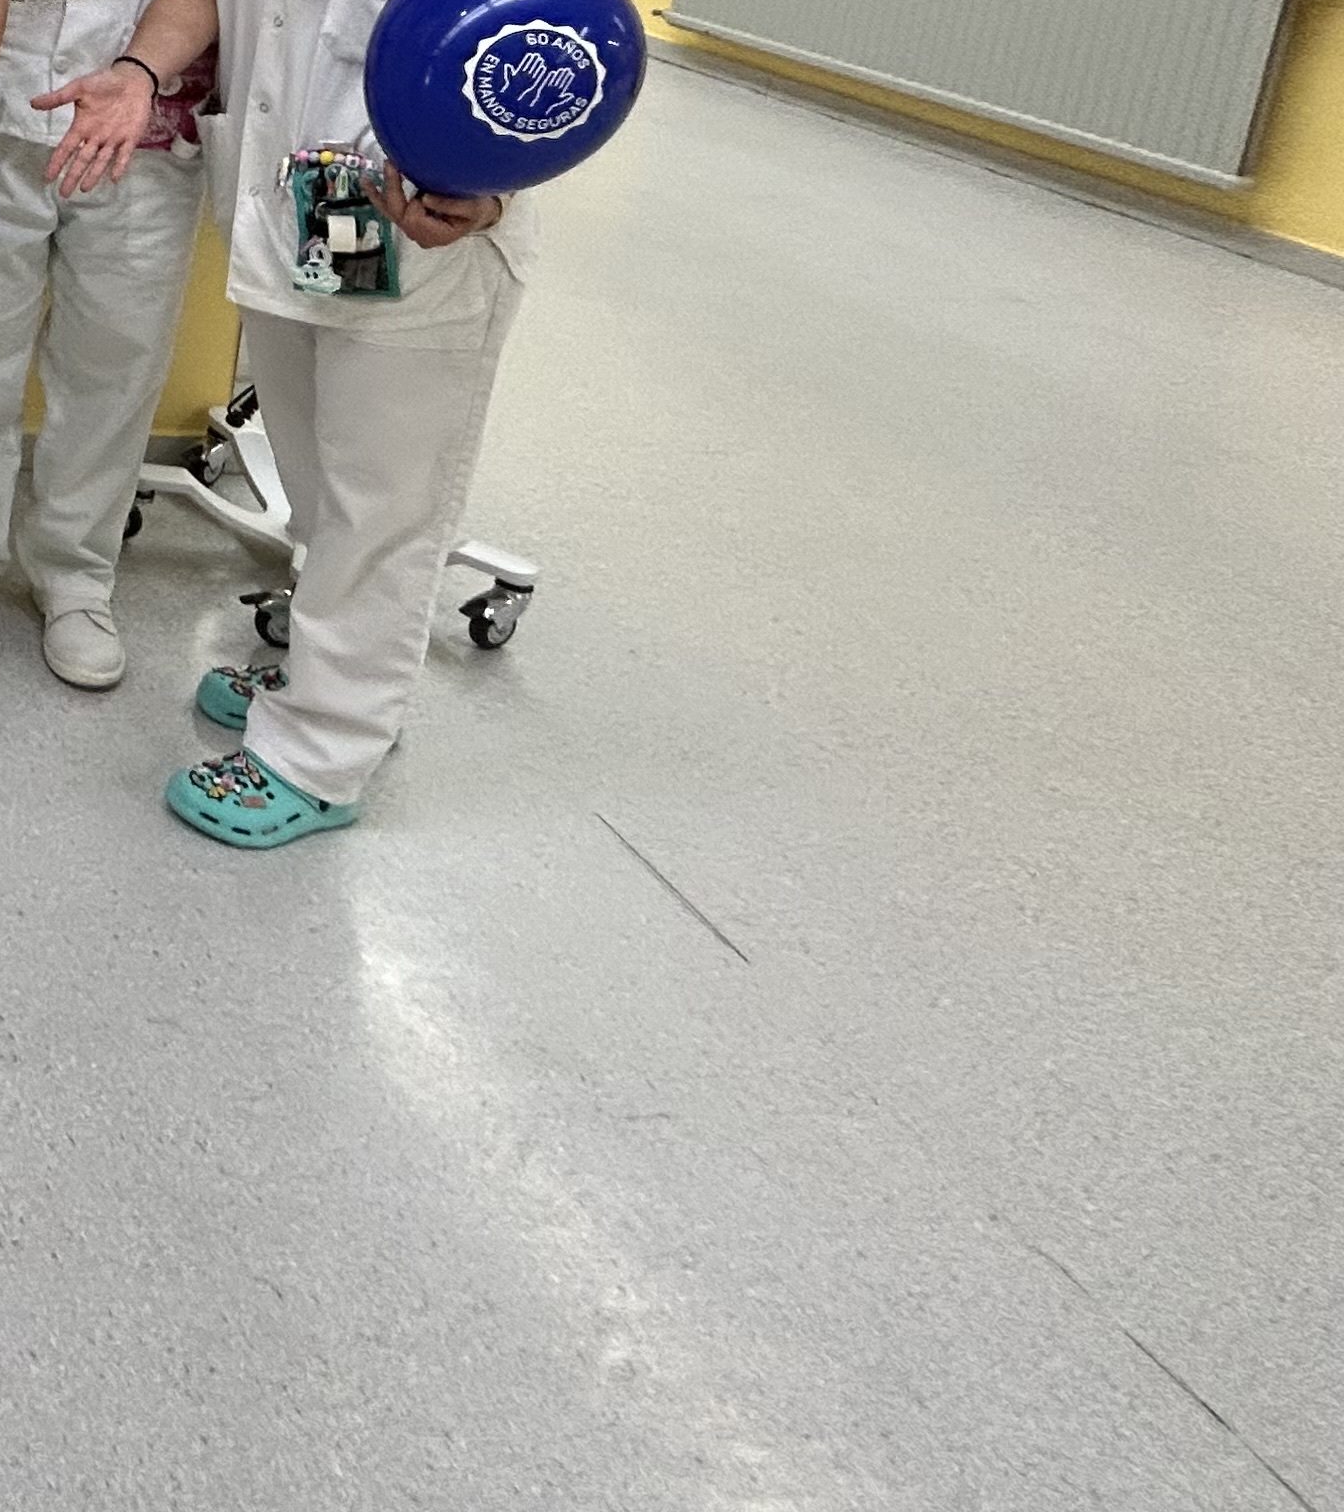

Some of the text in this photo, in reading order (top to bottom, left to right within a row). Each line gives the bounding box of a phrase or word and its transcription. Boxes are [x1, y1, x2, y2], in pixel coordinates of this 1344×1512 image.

[525, 33, 590, 69] 60 AÑOS
[478, 54, 588, 130] EN MANOS SEGURAS
